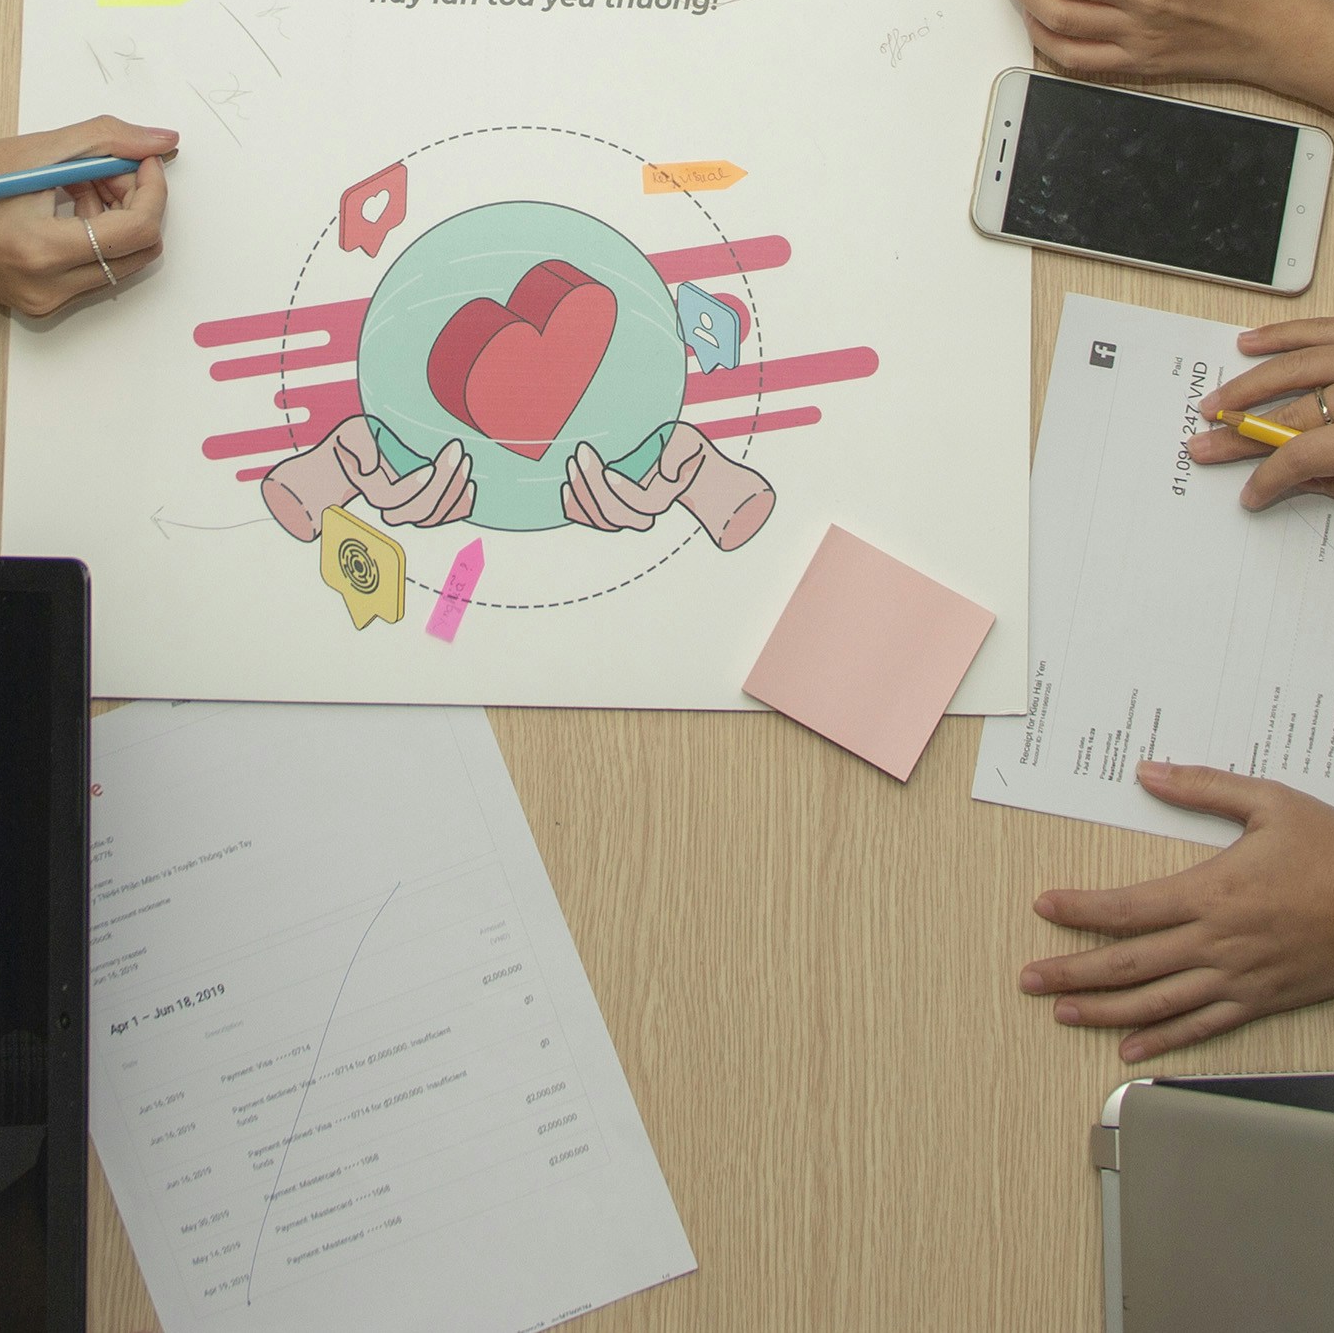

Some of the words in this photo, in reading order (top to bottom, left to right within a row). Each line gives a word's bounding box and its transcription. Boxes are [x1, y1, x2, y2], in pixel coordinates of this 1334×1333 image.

[1171, 356, 1183, 376] Paid
[1187, 360, 1208, 400] VND
[1035, 660, 1046, 677] Yen
[1032, 679, 1042, 694] Hai
[1026, 716, 1035, 729] for
[1020, 731, 1033, 764] Receipt
[1073, 749, 1083, 774] Payment
[110, 1020, 128, 1035] Apr
[131, 1015, 138, 1026] 1
[153, 1004, 174, 1019] Jun
[176, 995, 195, 1009] 18,
[195, 983, 224, 1003] 2019
